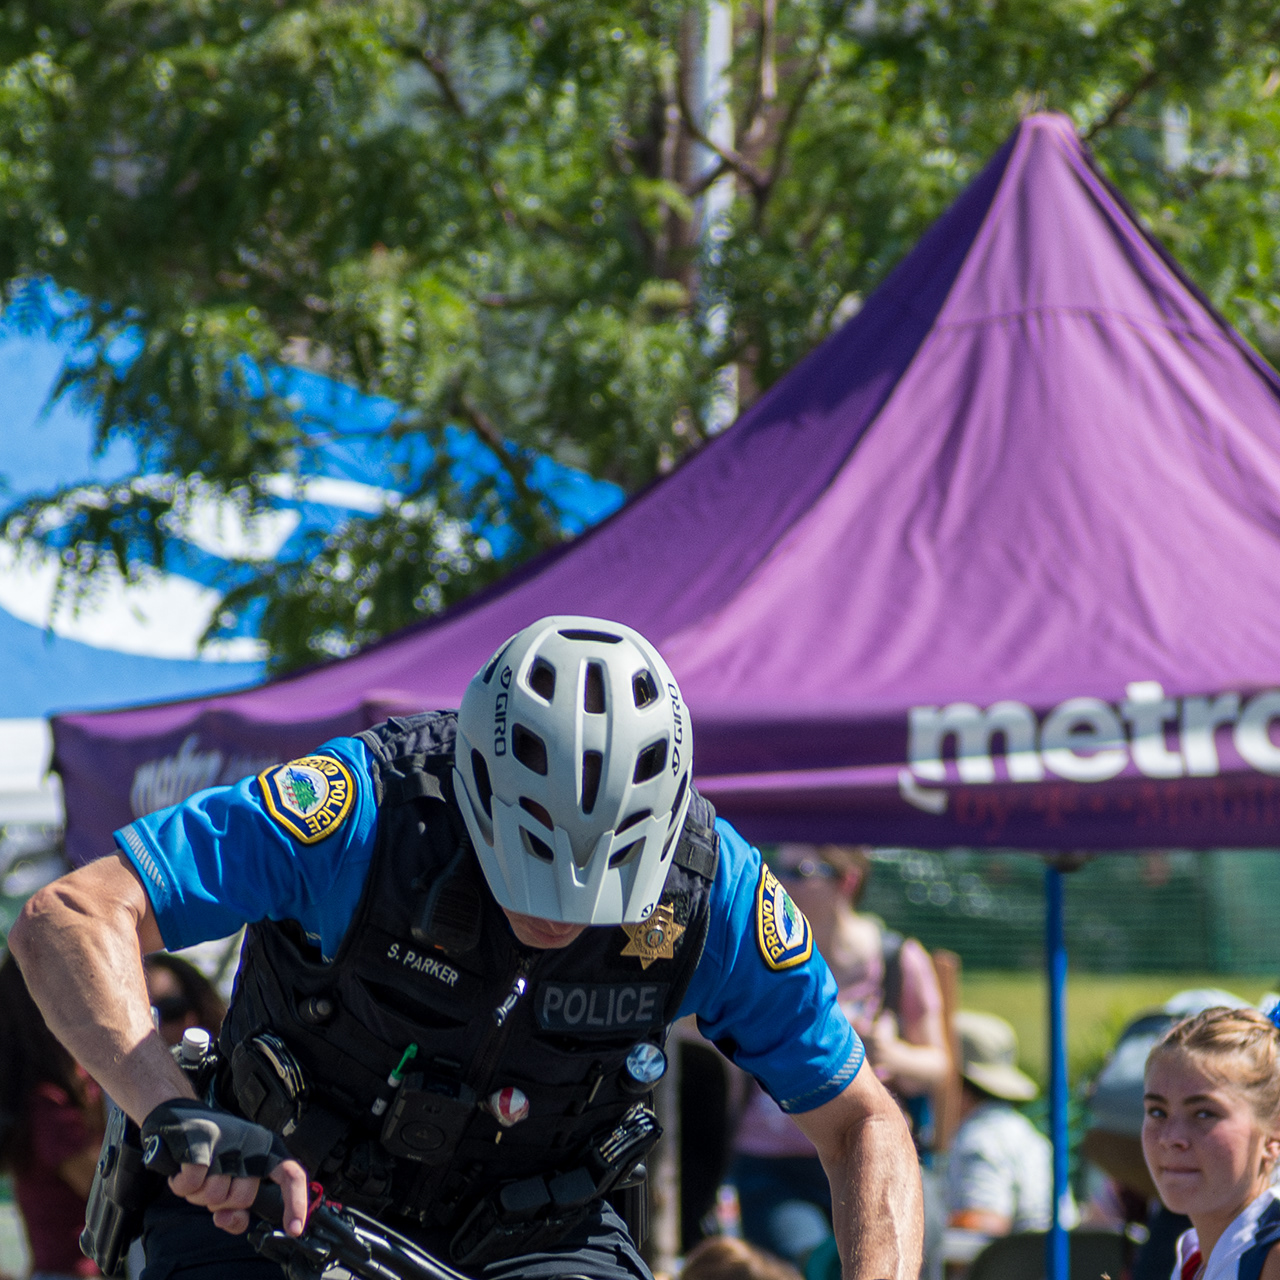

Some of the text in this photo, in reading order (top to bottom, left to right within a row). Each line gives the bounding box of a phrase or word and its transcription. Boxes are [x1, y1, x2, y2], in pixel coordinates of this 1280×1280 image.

[494, 692, 509, 757] GIRO
[667, 682, 683, 744] GIRO
[304, 780, 346, 834] POLICE
[763, 899, 786, 961] PROVO
[387, 943, 459, 988] S. PARKER
[542, 985, 658, 1027] POLICE
